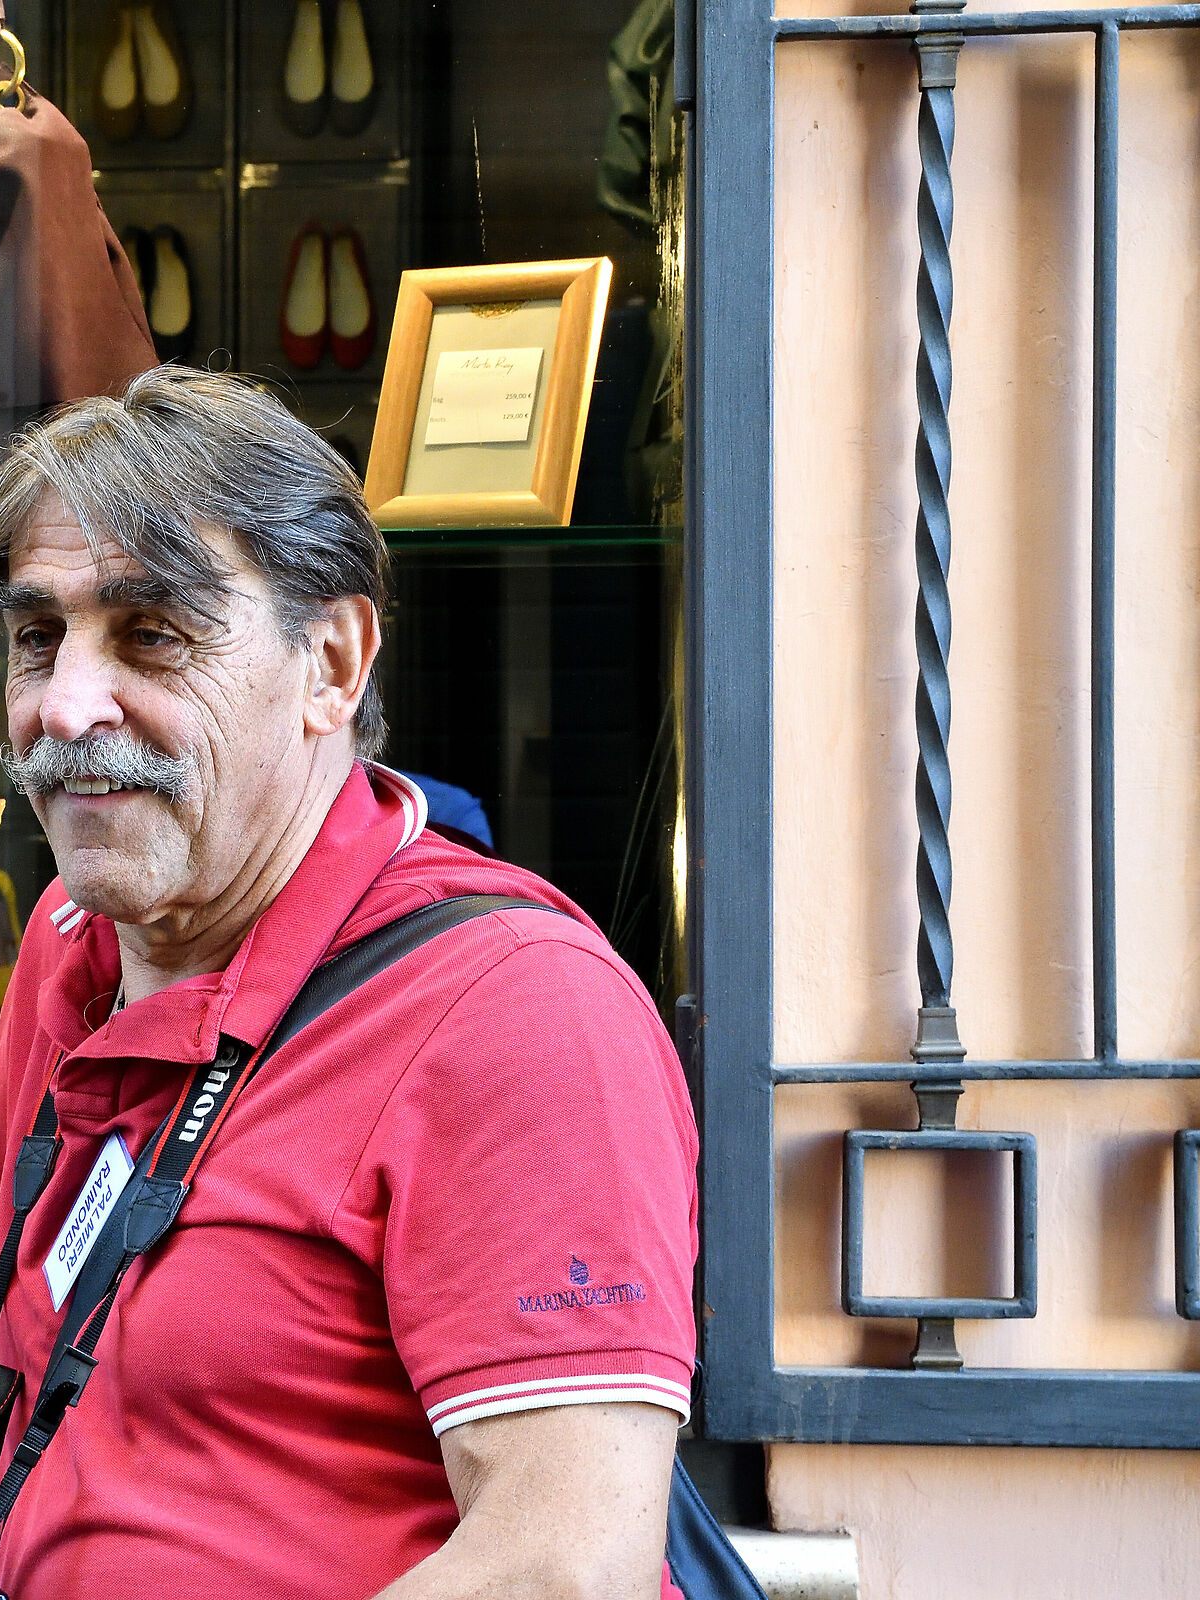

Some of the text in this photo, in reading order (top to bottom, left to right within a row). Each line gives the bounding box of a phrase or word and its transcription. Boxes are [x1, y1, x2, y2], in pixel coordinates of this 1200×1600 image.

[178, 1044, 240, 1142] anon
[58, 1159, 111, 1262] RAIMONDO
[66, 1183, 113, 1273] PALMIERI
[518, 1290, 582, 1312] MARINA
